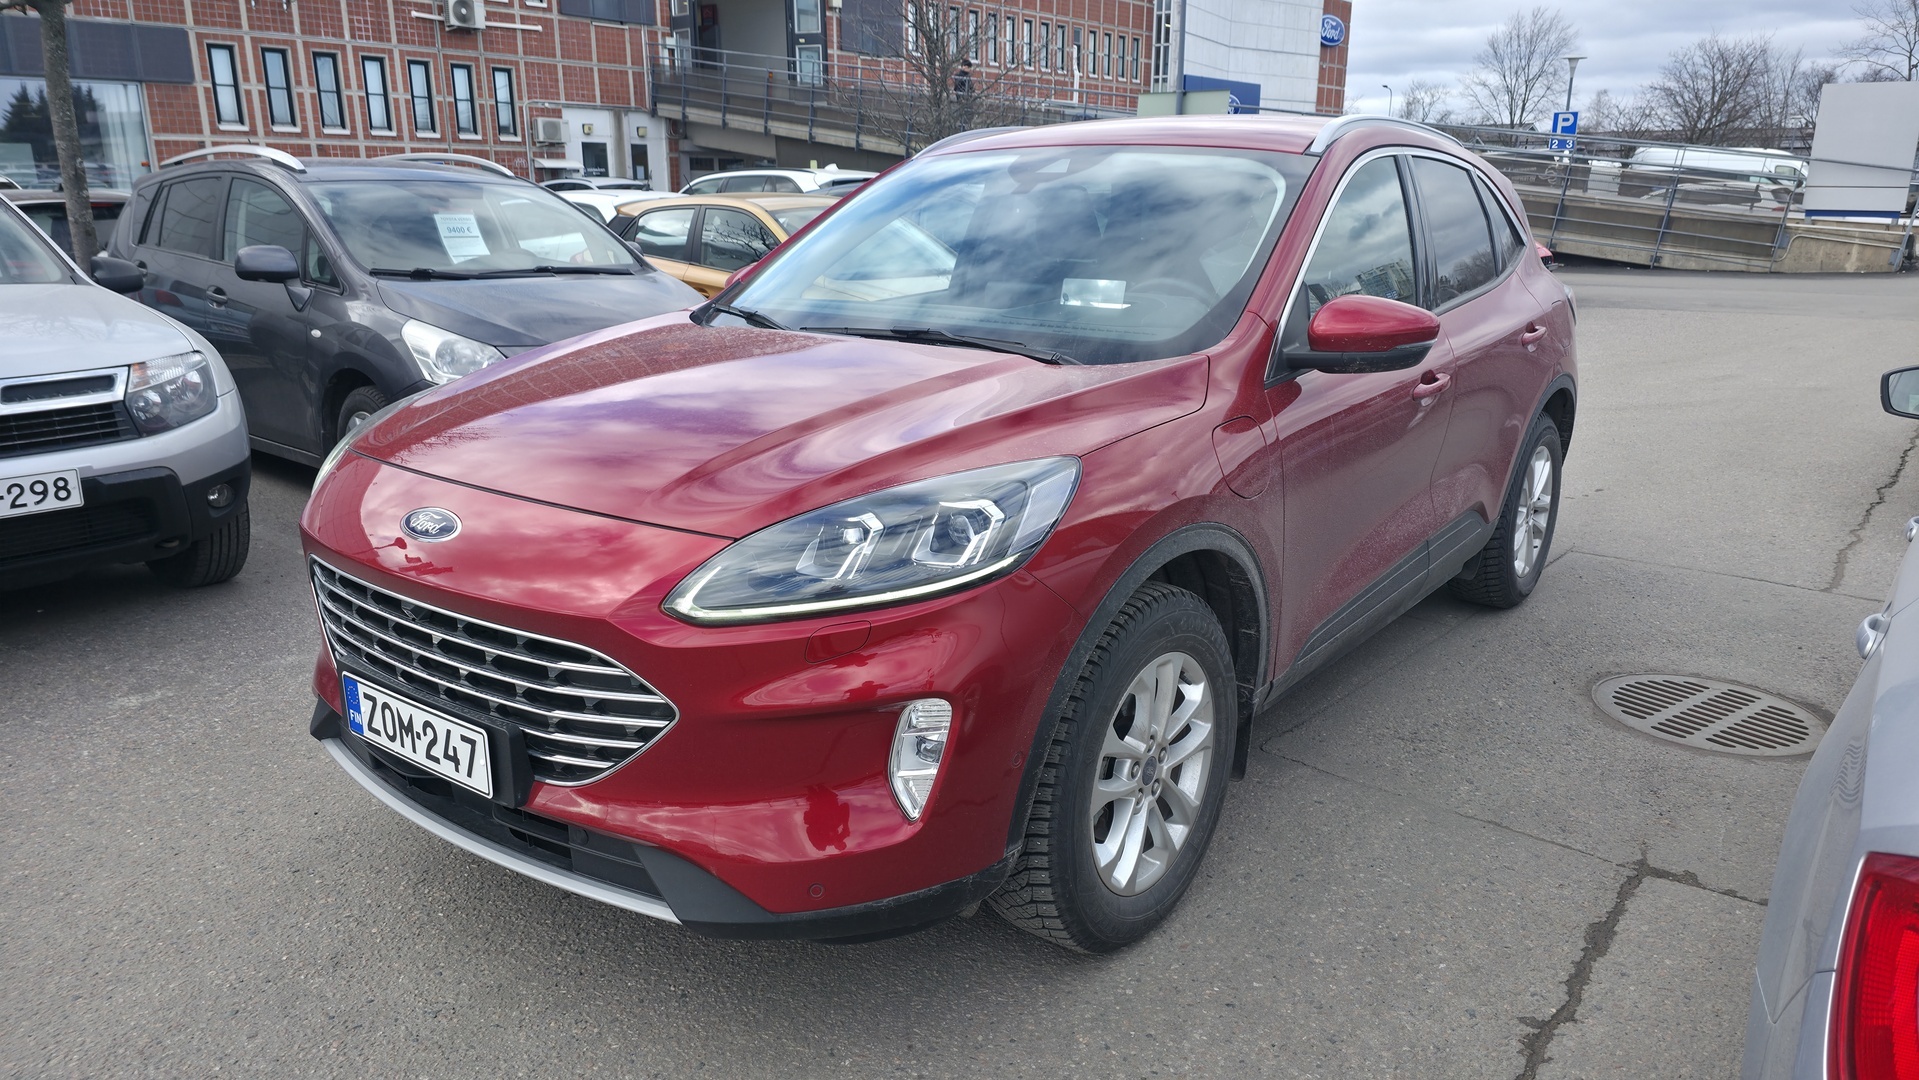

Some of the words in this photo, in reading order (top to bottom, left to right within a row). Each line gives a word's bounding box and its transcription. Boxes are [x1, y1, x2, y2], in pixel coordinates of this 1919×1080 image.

[1321, 18, 1341, 41] Ford
[1556, 113, 1575, 134] P
[1551, 139, 1559, 149] 2
[1565, 139, 1573, 149] 3
[446, 226, 466, 234] 9400
[466, 226, 473, 234] €
[410, 511, 446, 535] Ford
[349, 709, 363, 726] FIN
[362, 691, 477, 779] ZOM-247
